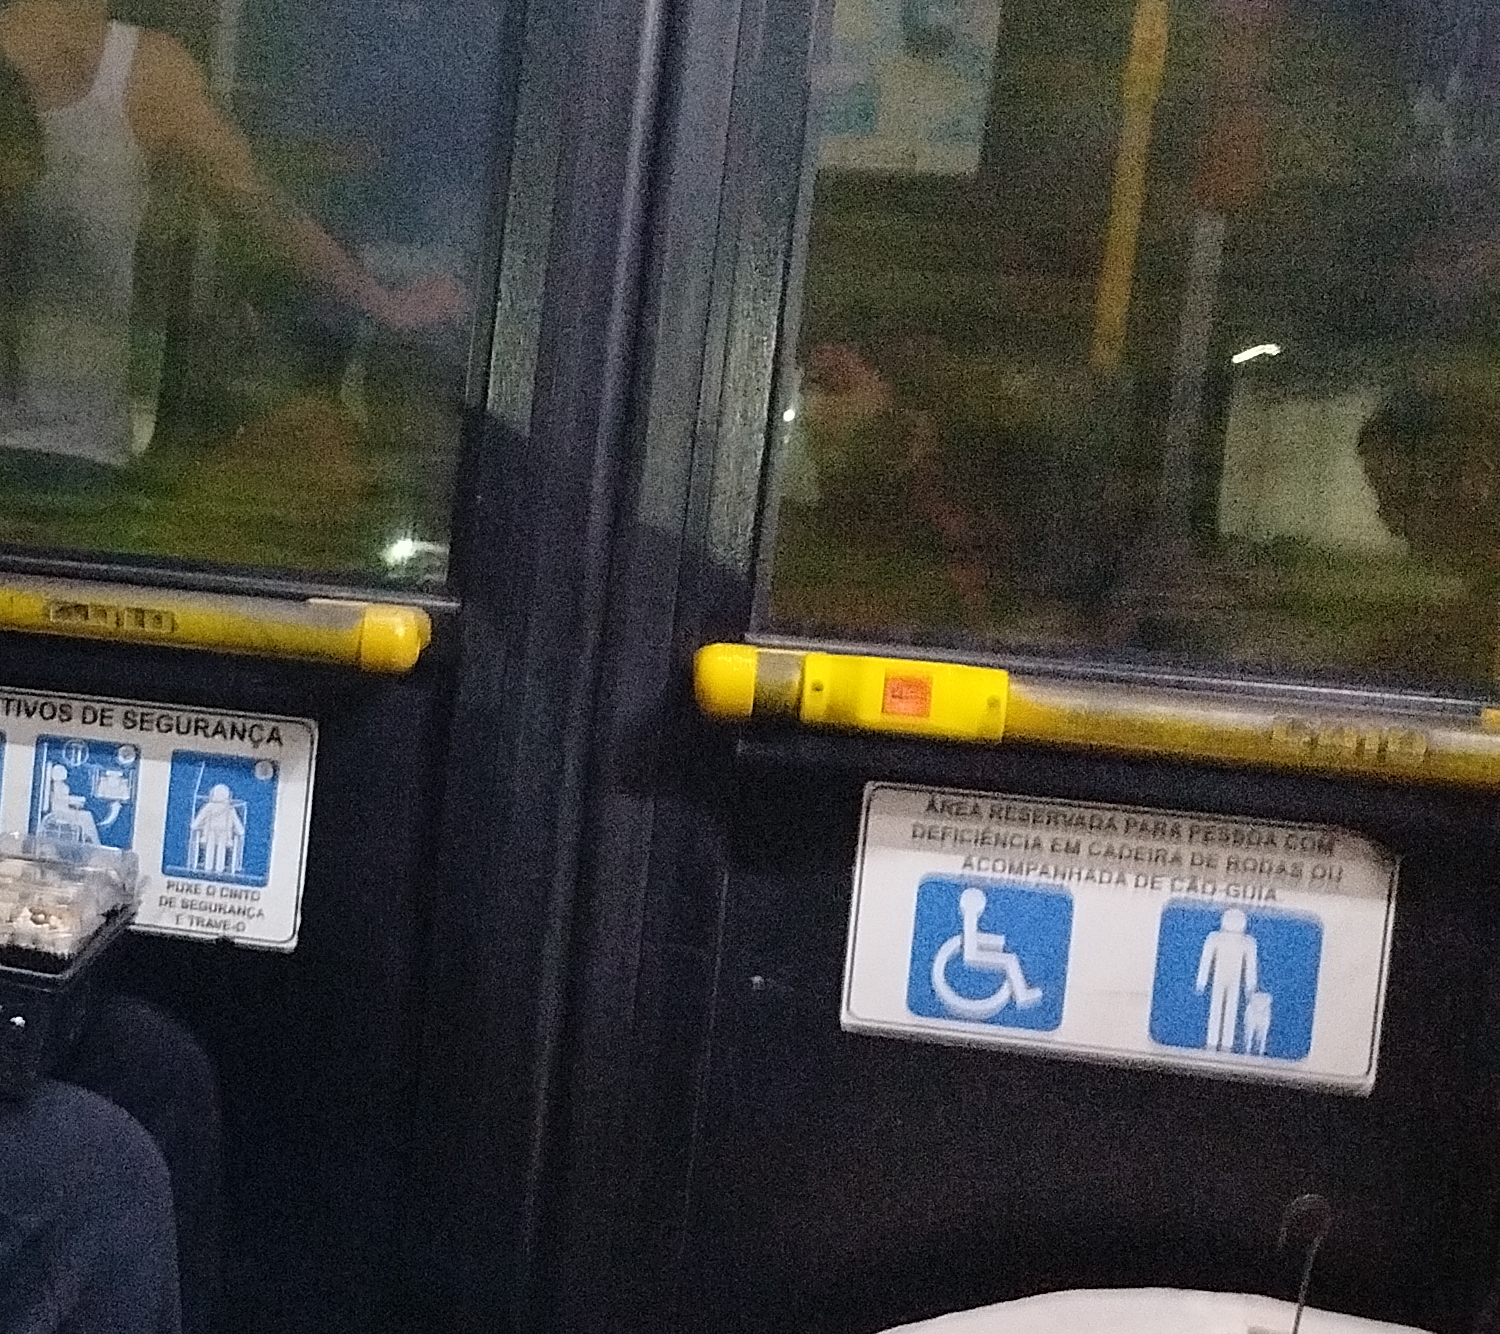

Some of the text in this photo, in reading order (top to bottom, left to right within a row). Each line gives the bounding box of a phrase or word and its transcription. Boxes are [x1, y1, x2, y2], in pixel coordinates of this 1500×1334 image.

[81, 705, 114, 727] DE
[122, 709, 283, 748] SEGURANÇA
[989, 803, 1118, 831] RESERVADA
[1124, 818, 1181, 839] PARA
[1284, 833, 1337, 855] COM
[911, 821, 1043, 850] DEFICIÊNCIA
[1051, 838, 1081, 855] EM
[1088, 841, 1182, 865] CADEIRA
[1190, 851, 1217, 868] DE
[1226, 855, 1303, 878] RODAS
[206, 885, 216, 896] O
[961, 855, 1127, 886] ACOMPANHADA
[1134, 875, 1163, 891] DE
[159, 895, 265, 919] DE SEGURANÇA
